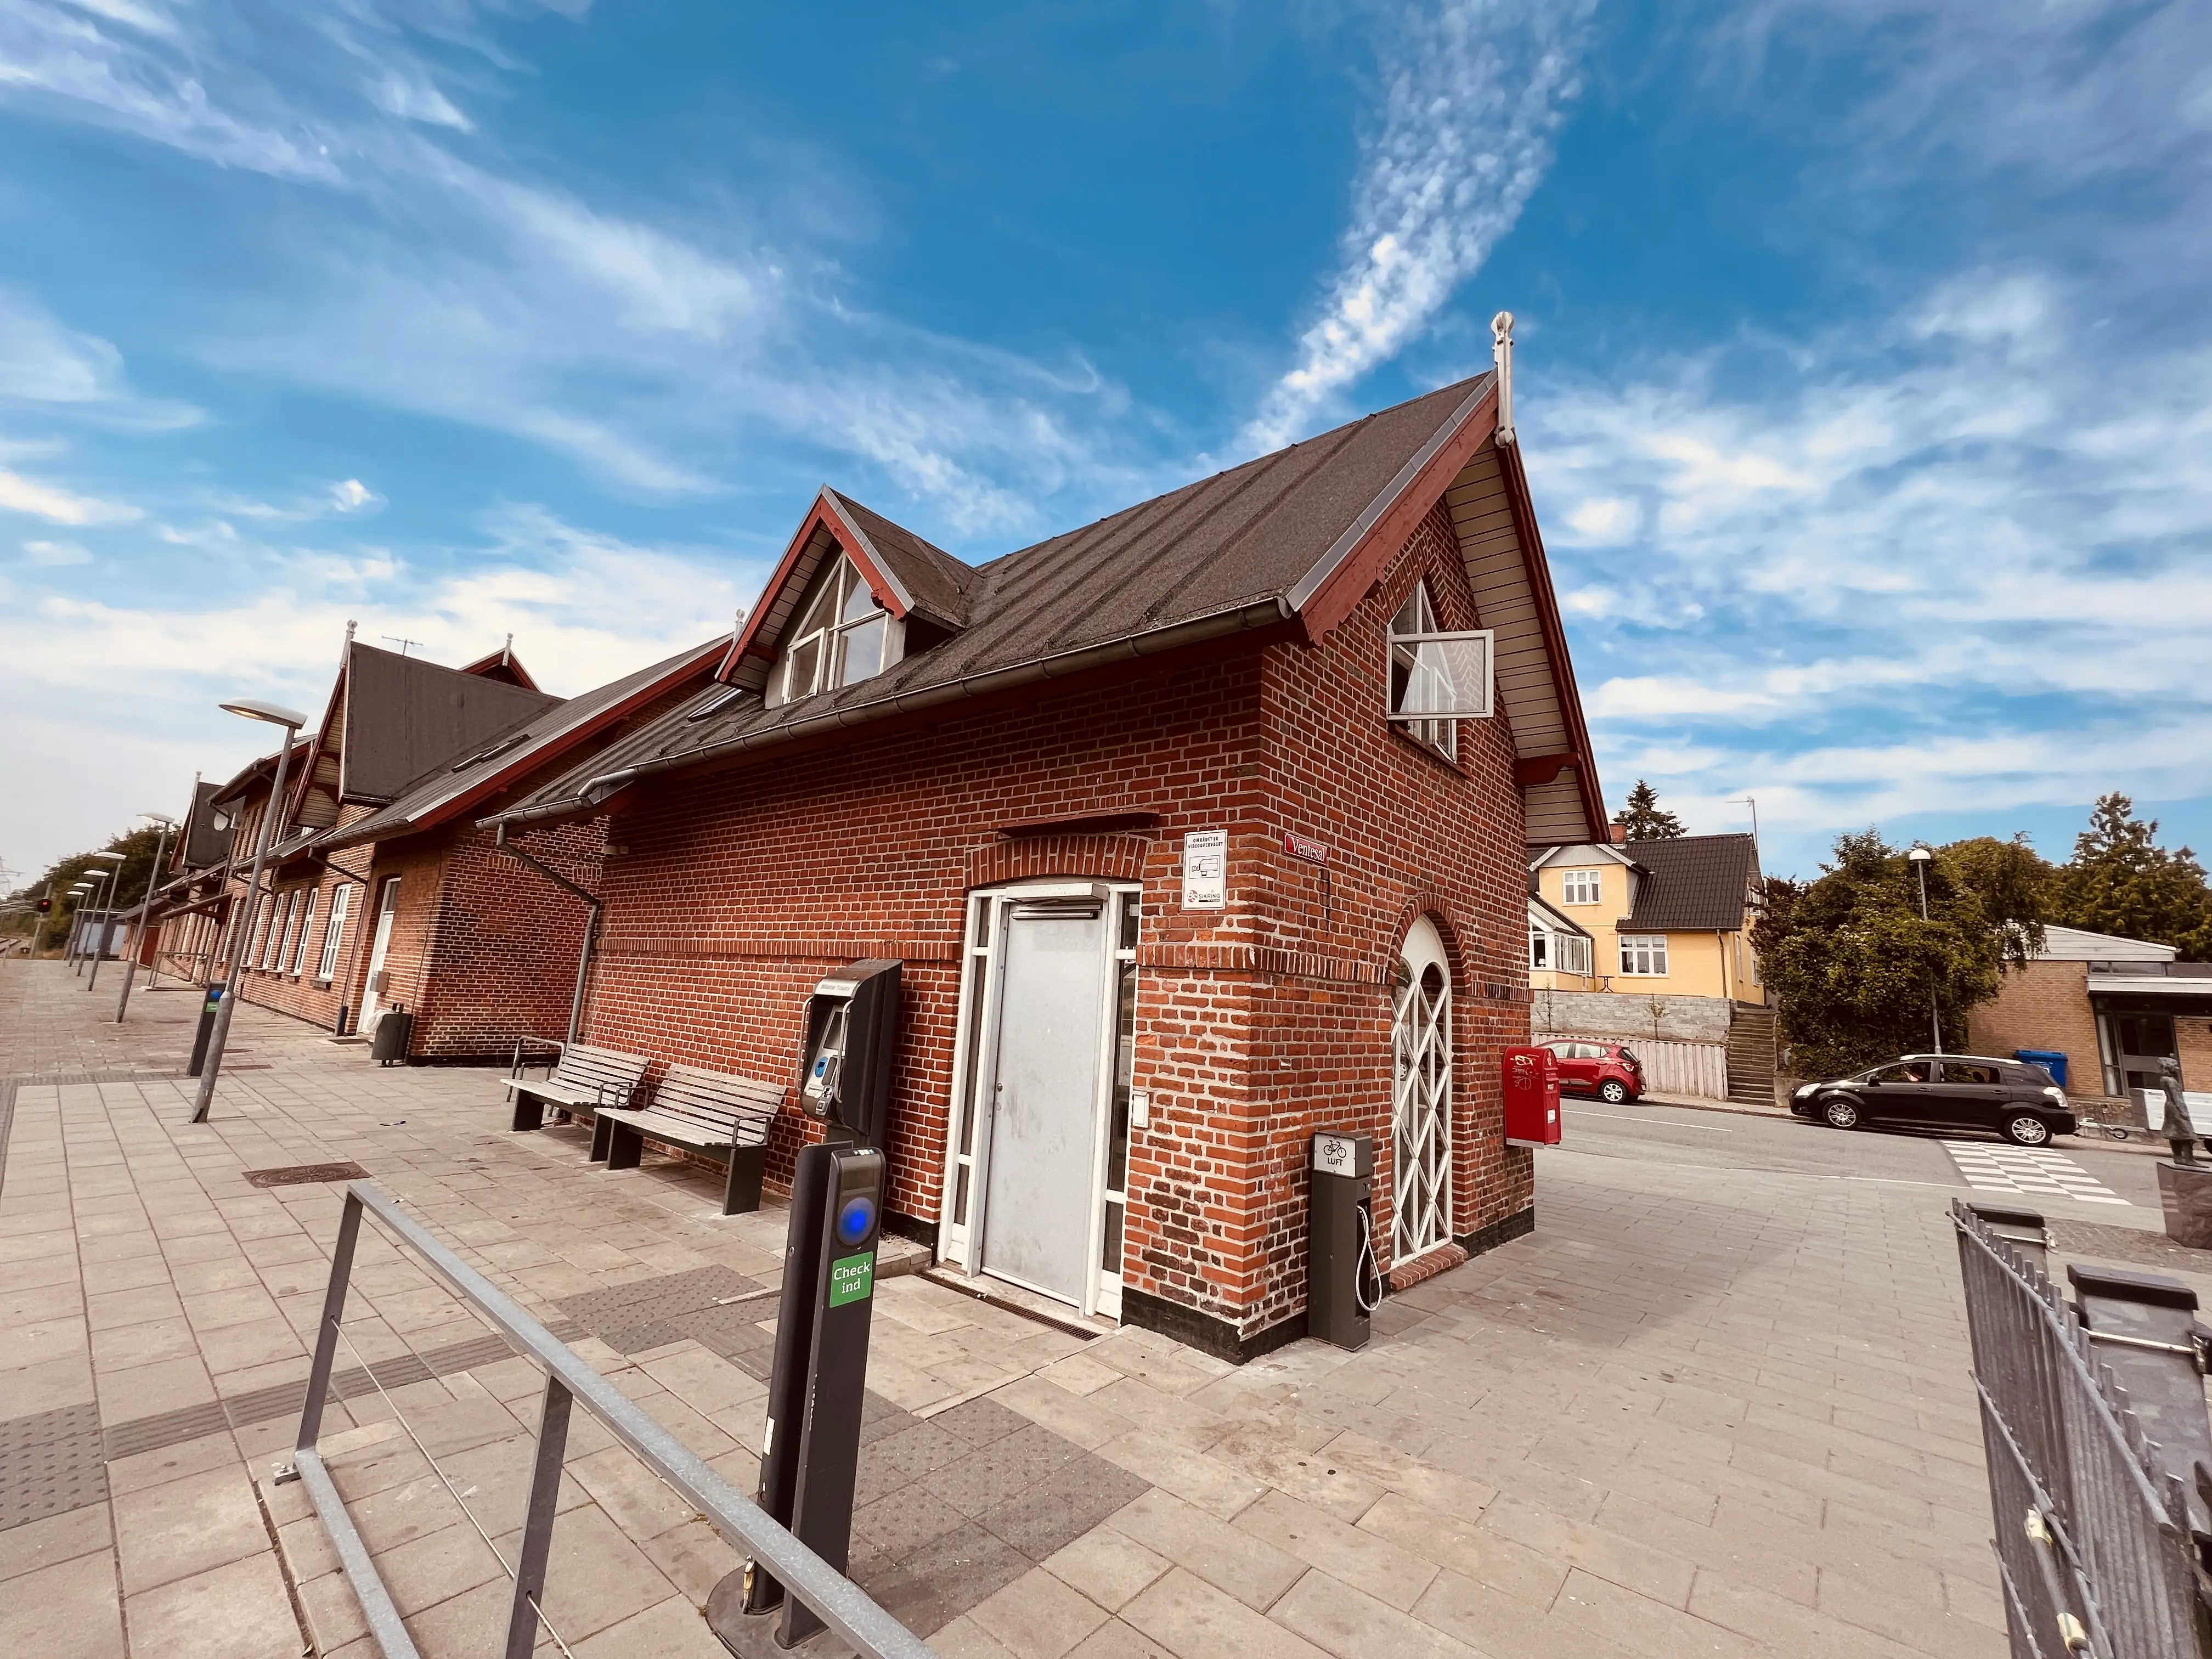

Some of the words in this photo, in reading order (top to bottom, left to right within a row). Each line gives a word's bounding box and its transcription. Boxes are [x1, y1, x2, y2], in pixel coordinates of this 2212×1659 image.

[1290, 836, 1324, 862] Ventesal
[1327, 1157, 1343, 1166] LUFT
[834, 1261, 871, 1280] Check
[841, 1278, 861, 1294] ind
